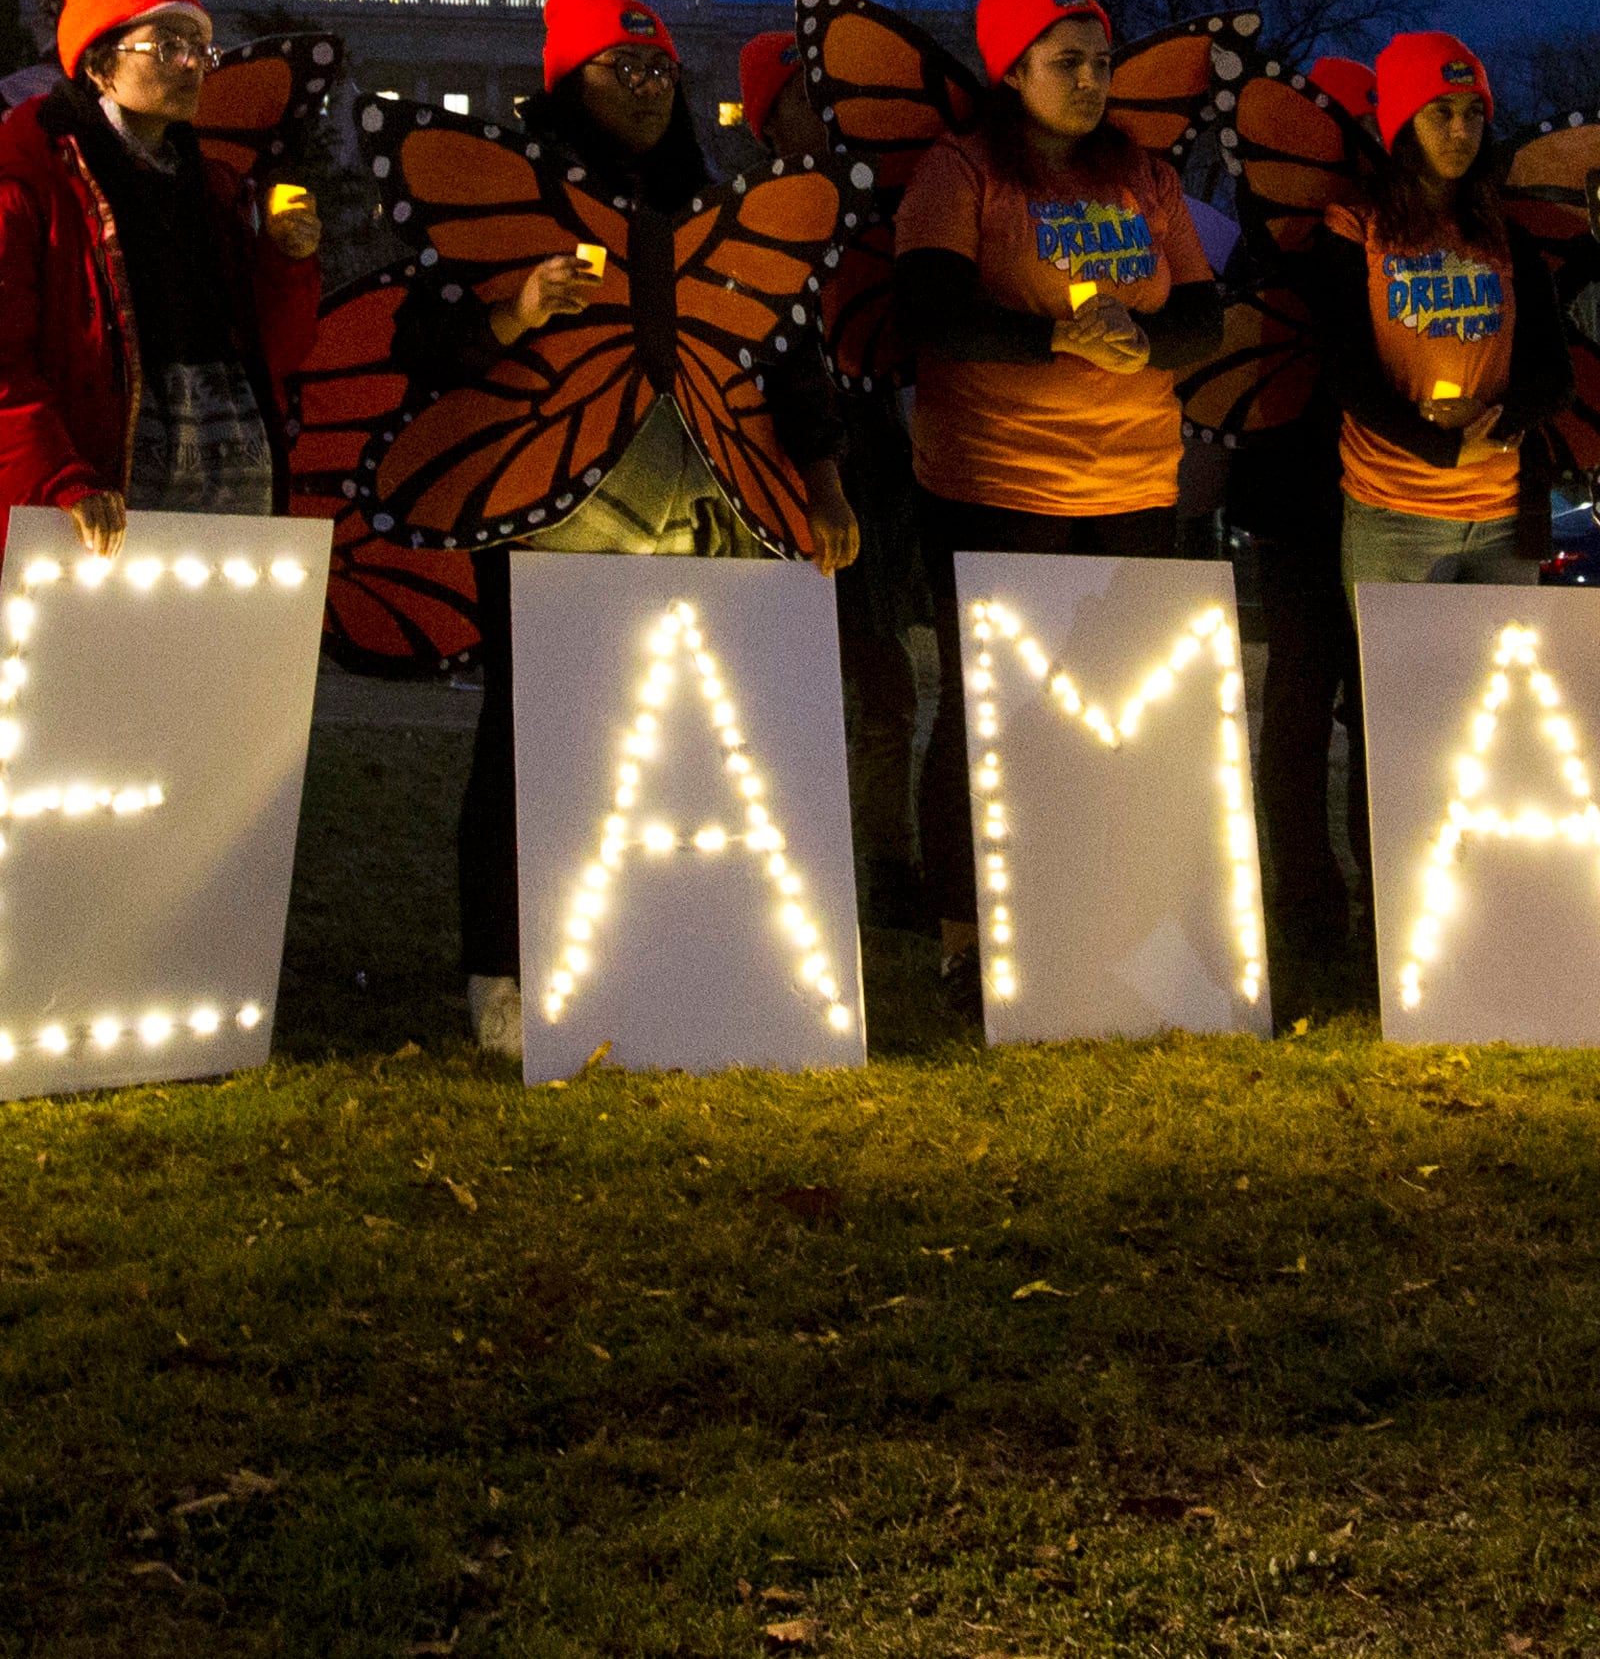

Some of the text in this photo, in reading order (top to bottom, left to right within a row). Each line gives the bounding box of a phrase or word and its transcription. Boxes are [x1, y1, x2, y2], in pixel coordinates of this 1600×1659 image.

[1036, 214, 1153, 260] DREAM
[1082, 258, 1112, 281] ACT
[1388, 272, 1503, 320] DREAM
